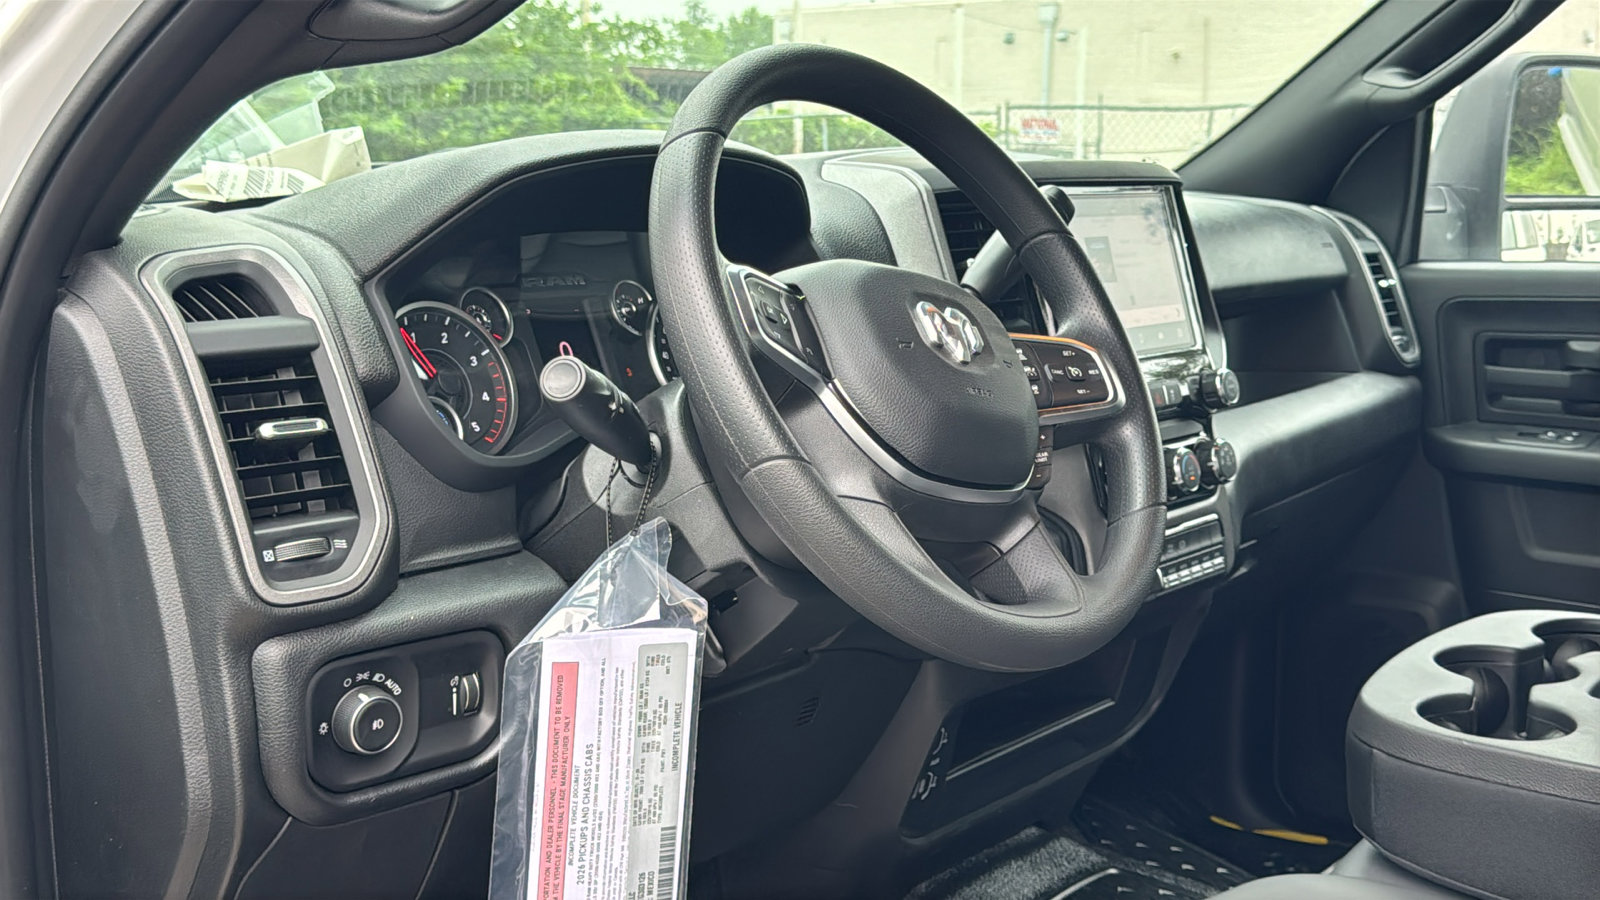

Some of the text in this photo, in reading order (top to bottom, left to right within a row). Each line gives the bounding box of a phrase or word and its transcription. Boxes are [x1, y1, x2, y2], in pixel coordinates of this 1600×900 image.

[441, 332, 448, 344] 2
[470, 356, 478, 367] 3
[482, 392, 490, 402] 4
[471, 422, 480, 432] 5
[384, 678, 402, 696] AUTO
[554, 716, 560, 724] TO
[552, 727, 560, 762] DOCUMENT
[671, 701, 682, 771] INCOMPLETE VEHICLE
[548, 786, 556, 822] PERSONNEL
[555, 844, 562, 852] BY
[560, 735, 569, 786] MANUFACTURER
[567, 828, 576, 865] INCOMPLETE
[572, 764, 580, 798] DOCUMENT
[576, 743, 593, 885] 2026 PICKUPS AND CHASSIS CABS
[646, 870, 654, 896] MEXICO
